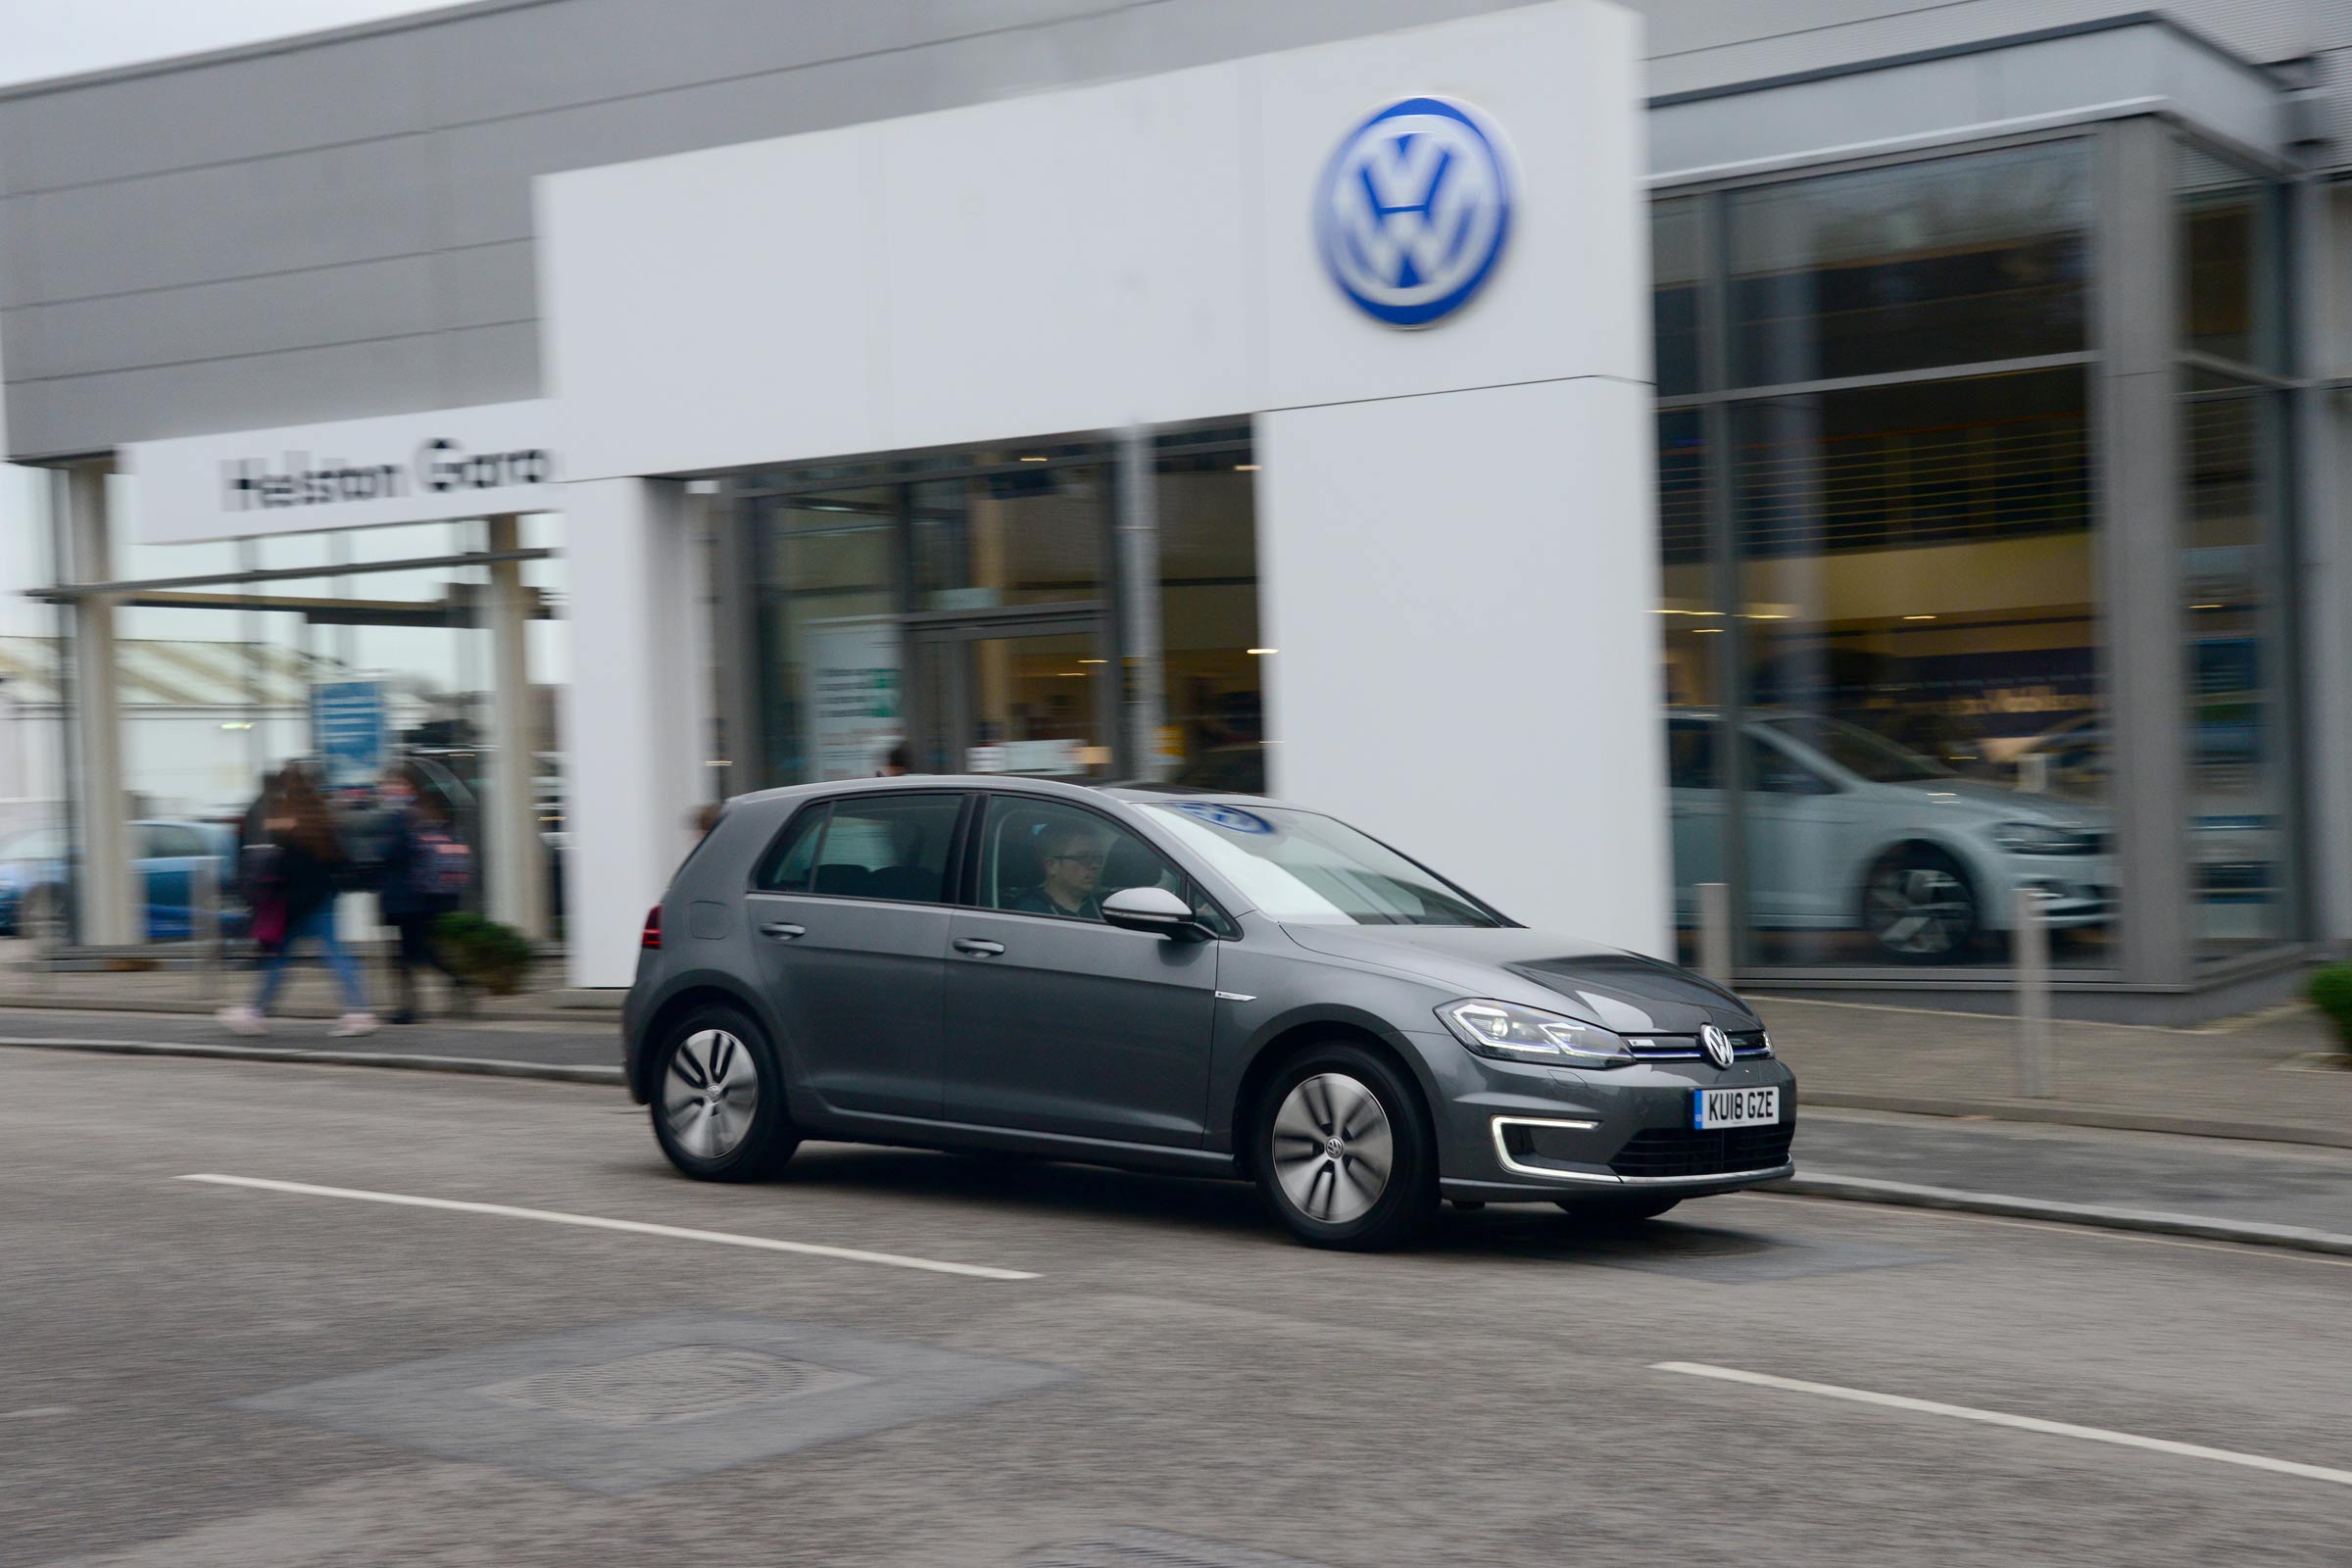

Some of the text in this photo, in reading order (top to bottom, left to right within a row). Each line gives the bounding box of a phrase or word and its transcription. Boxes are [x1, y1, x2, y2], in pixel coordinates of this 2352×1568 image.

[221, 449, 408, 511] Helston
[1703, 1025, 1734, 1067] VW
[1708, 1090, 1774, 1121] KU18 GZE
